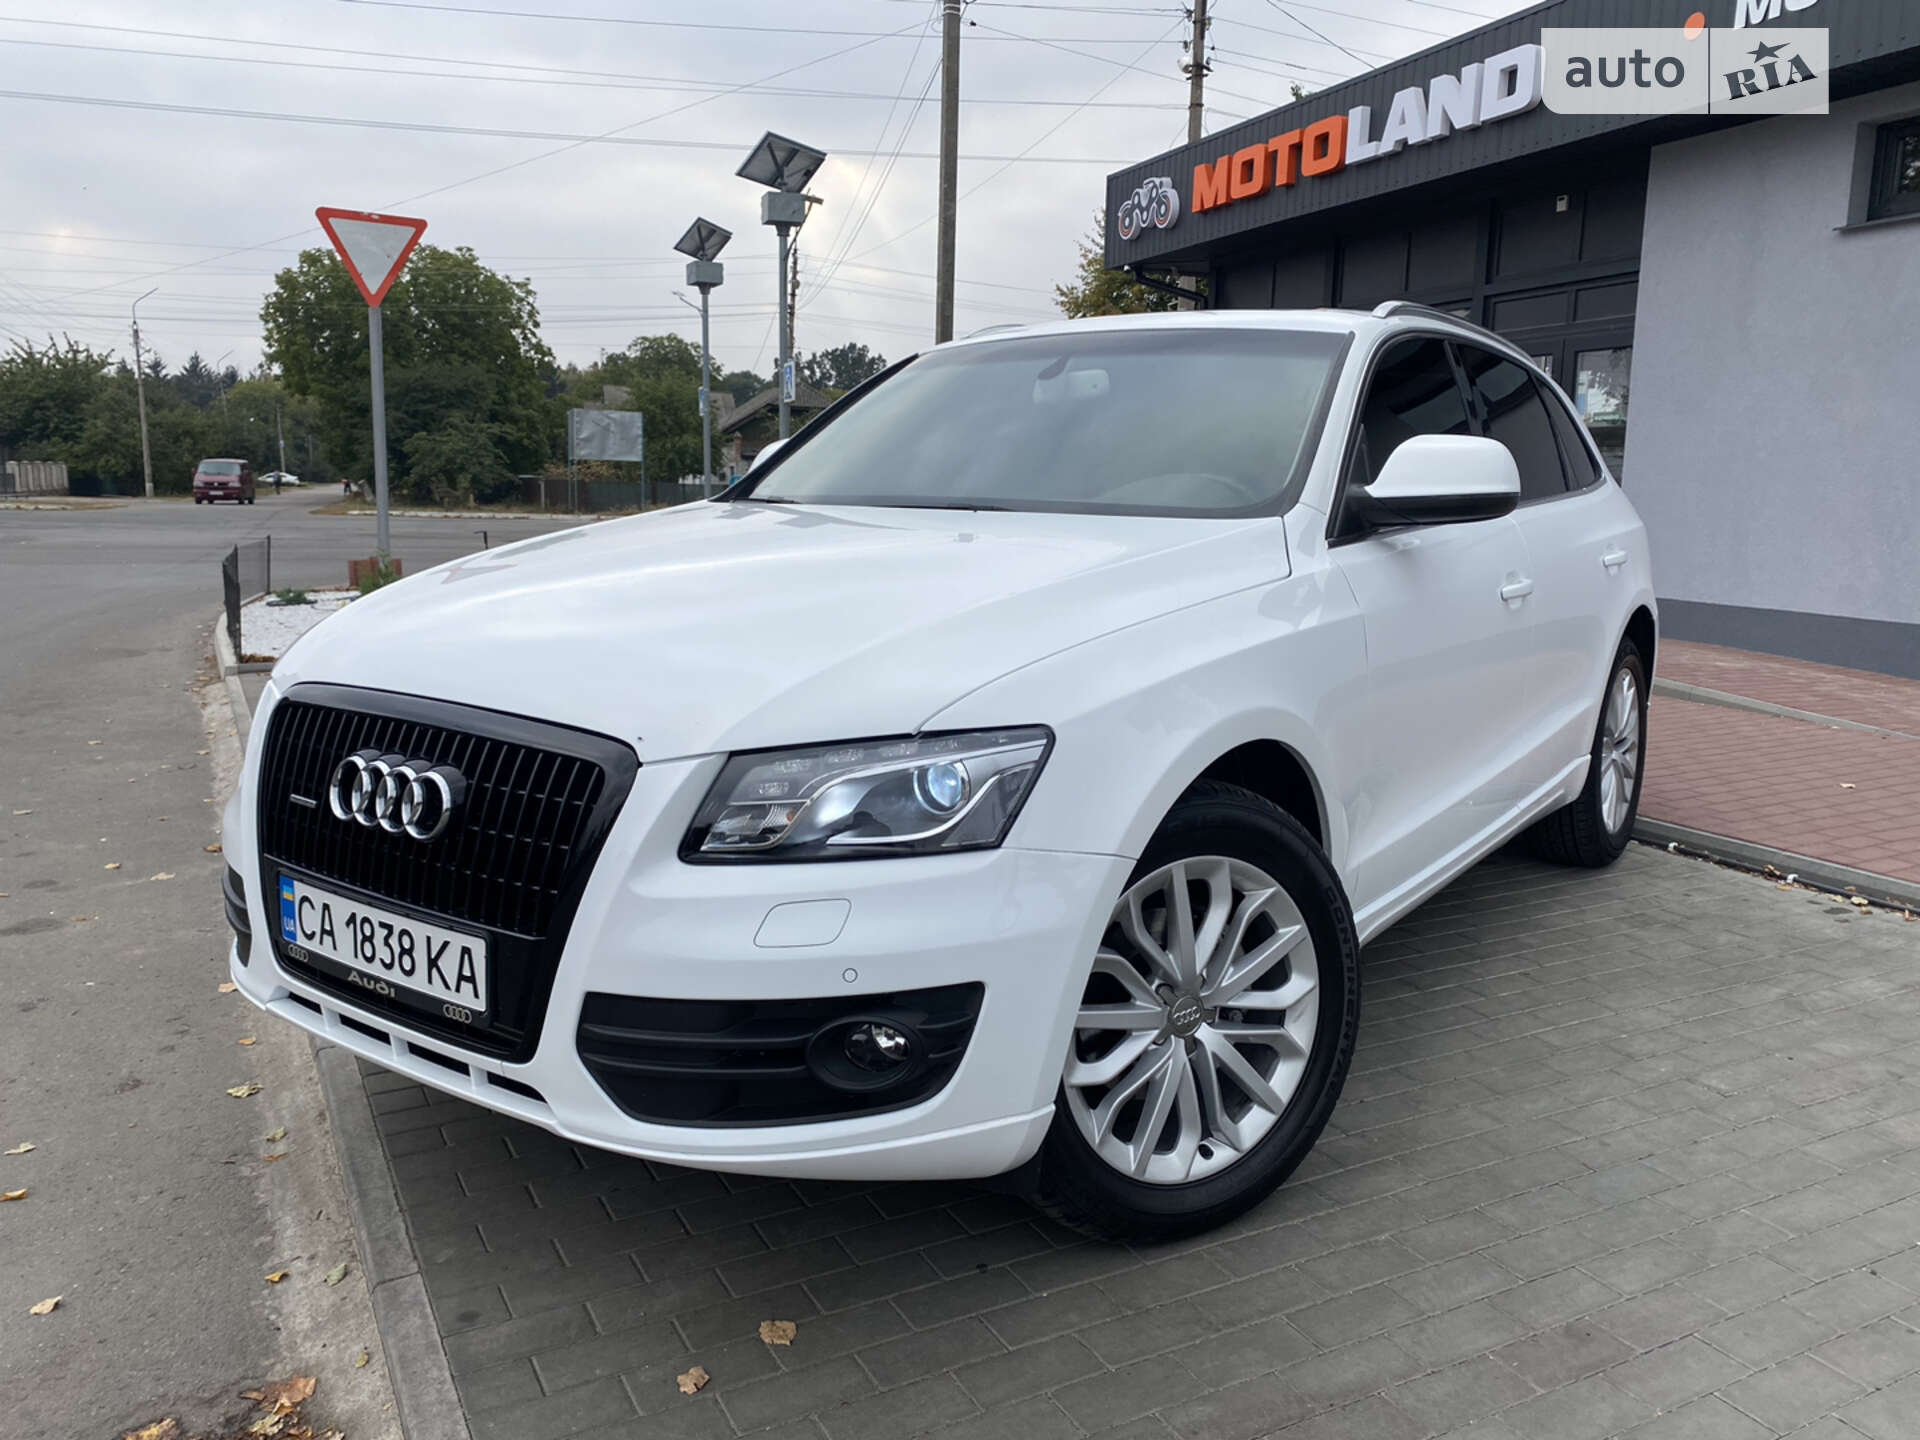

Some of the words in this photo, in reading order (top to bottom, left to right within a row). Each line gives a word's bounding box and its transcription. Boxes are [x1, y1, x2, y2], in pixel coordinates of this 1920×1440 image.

[283, 916, 296, 932] UA
[299, 895, 338, 951] CA
[345, 911, 416, 977] 1838
[425, 935, 481, 1000] KA
[347, 970, 396, 998] Audi
